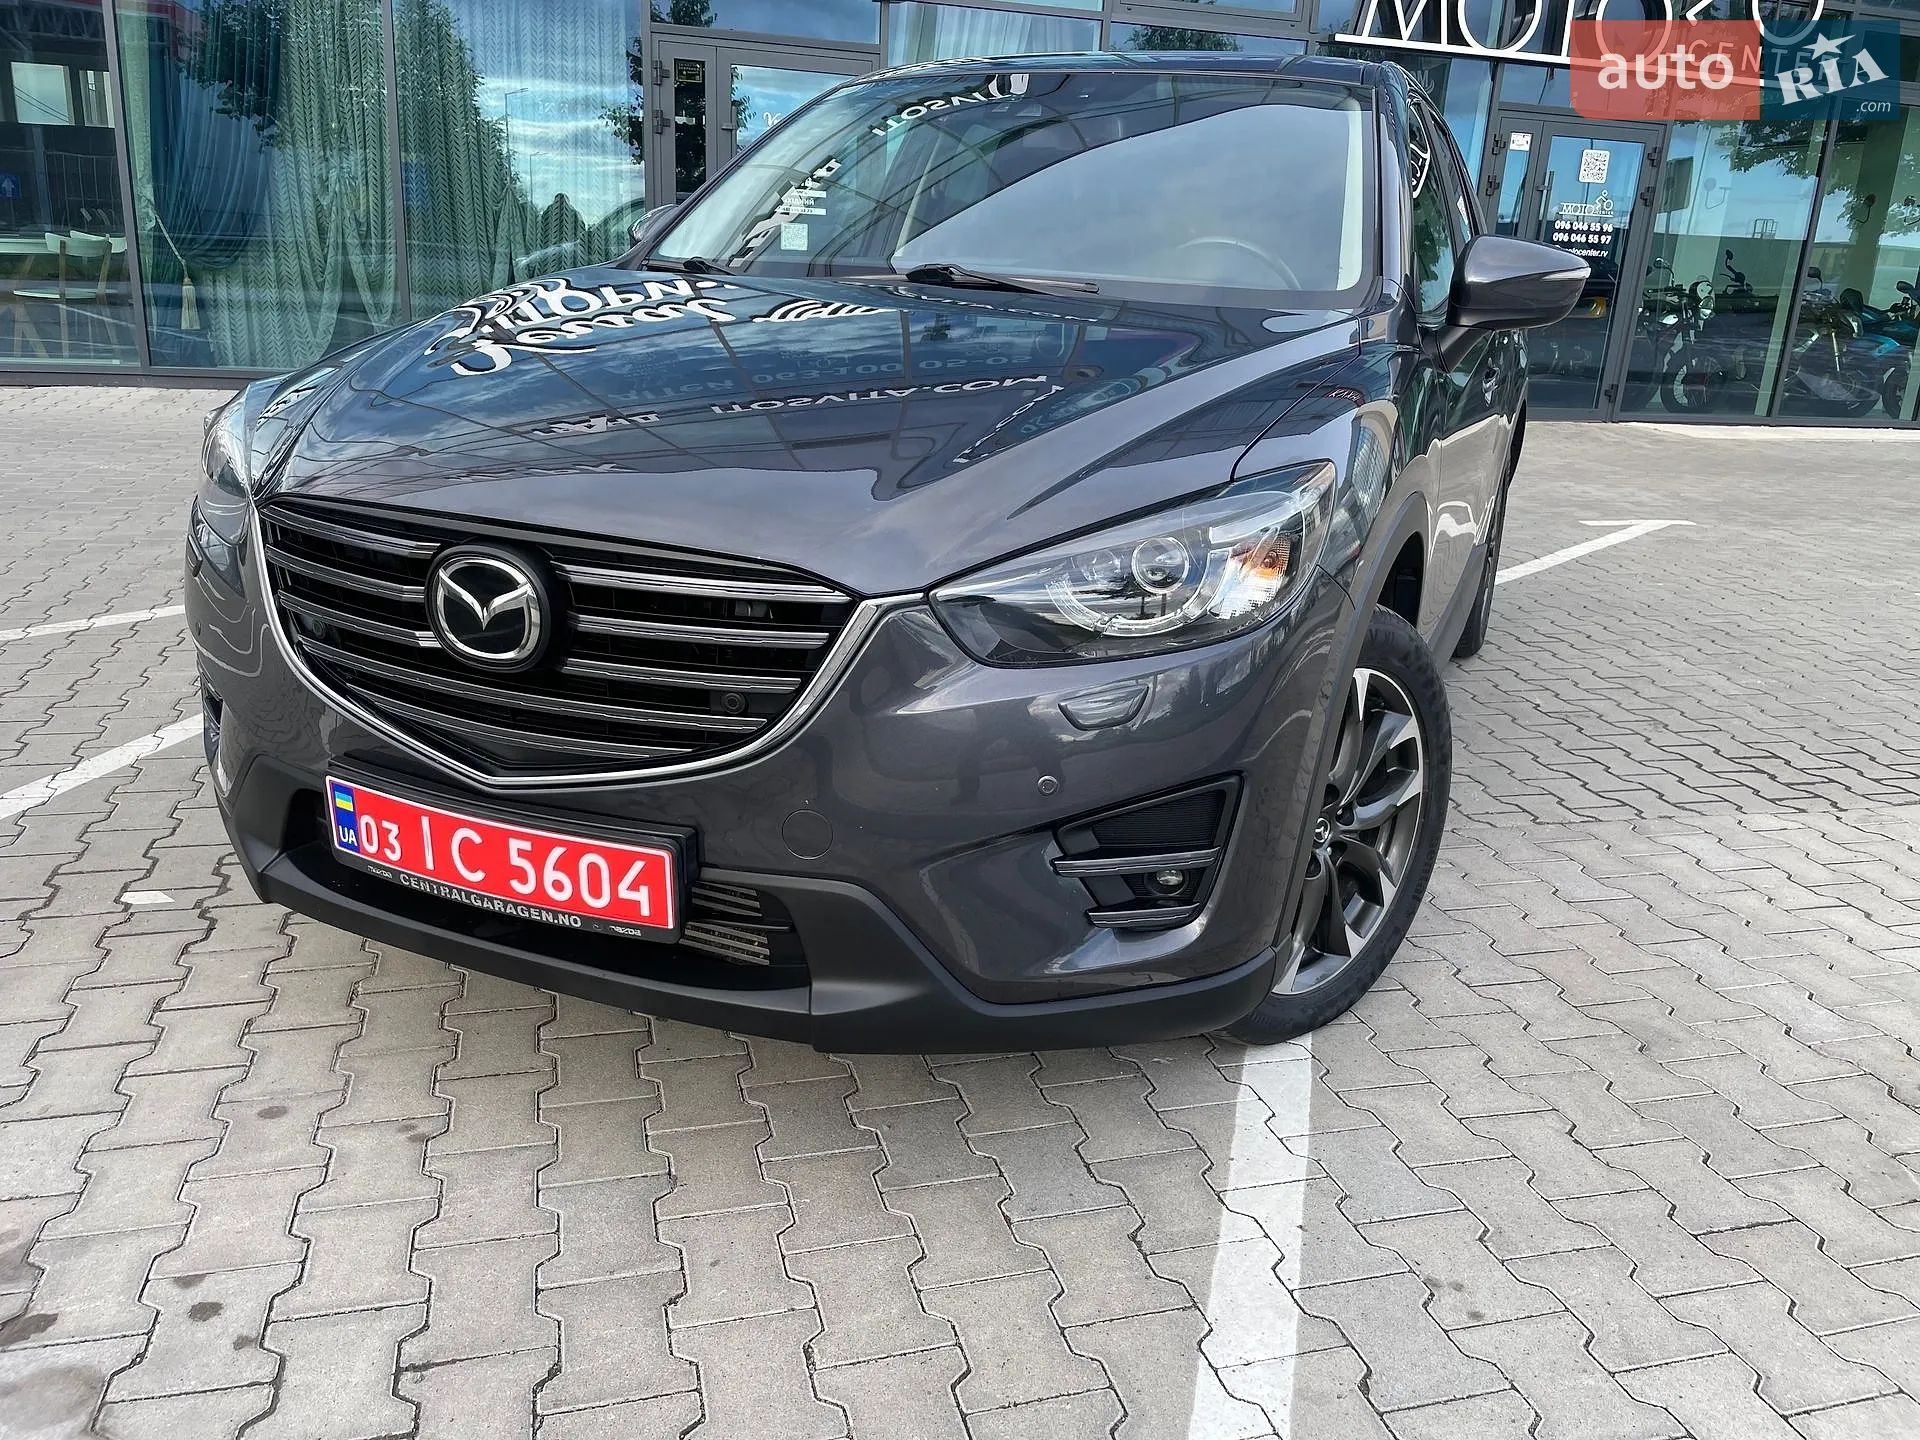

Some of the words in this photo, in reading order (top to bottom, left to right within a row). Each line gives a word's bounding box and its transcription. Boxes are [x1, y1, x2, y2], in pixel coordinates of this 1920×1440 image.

[1554, 220, 1571, 230] 096
[1572, 221, 1588, 231] 046
[1590, 222, 1601, 232] 55
[1602, 223, 1613, 233] 96
[1552, 232, 1569, 242] 096
[1570, 233, 1587, 243] 046
[1587, 234, 1599, 244] 55
[1600, 235, 1612, 245] 97
[1556, 246, 1609, 257] otocenter.rv
[339, 824, 358, 847] UA
[359, 814, 402, 863] 03
[508, 838, 651, 917] 5604
[399, 873, 583, 929] CENTRALGARAGEN.NO
